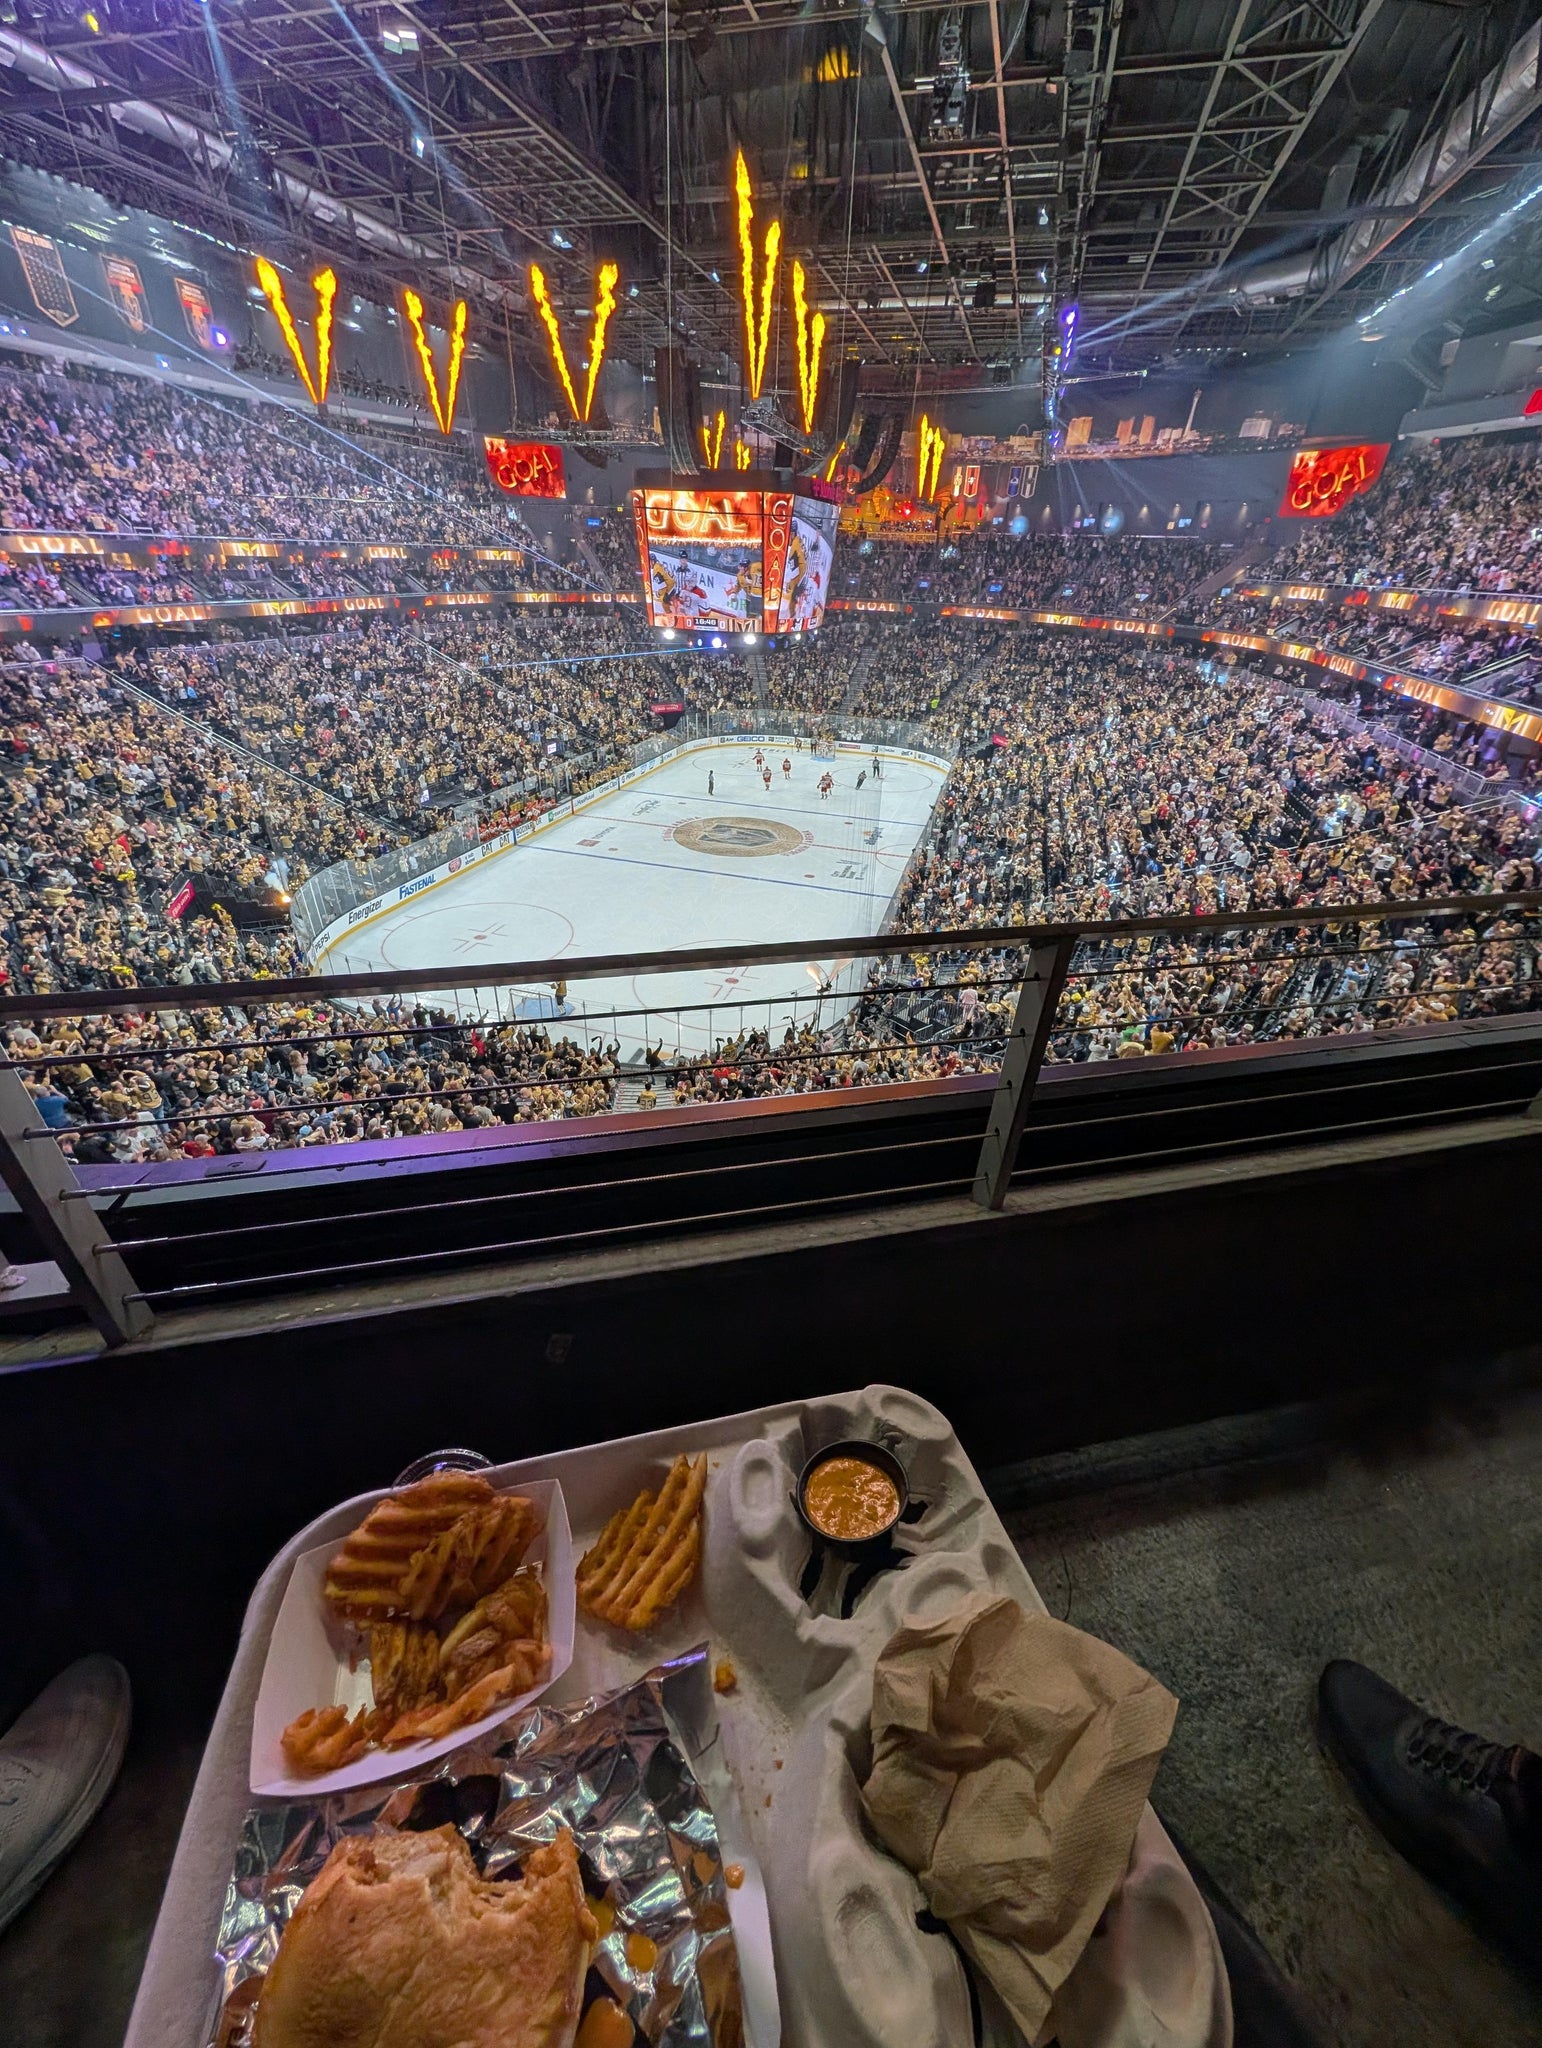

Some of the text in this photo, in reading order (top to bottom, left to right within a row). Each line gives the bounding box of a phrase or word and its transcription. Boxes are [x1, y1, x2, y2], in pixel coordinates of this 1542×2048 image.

[497, 447, 557, 488] GOAL
[1292, 456, 1374, 509] GOAL
[646, 495, 748, 533] GOAL
[17, 536, 104, 555] GOAL
[369, 547, 407, 559] GOAL
[447, 594, 483, 605] GOAL
[1288, 586, 1326, 601] GOAL
[345, 598, 384, 610] GOAL
[856, 602, 895, 612] GOAL
[137, 606, 208, 623] GOAL
[965, 607, 1003, 619] GOAL
[1486, 601, 1542, 625] GOAL
[1114, 619, 1157, 634] GOAL
[1222, 633, 1264, 649] GOAL
[1329, 655, 1357, 676] GOAL
[1403, 684, 1443, 704] GOAL
[499, 833, 510, 848] CAT
[481, 842, 493, 857] CAT
[399, 874, 436, 900] FASTENAL
[348, 899, 383, 925] Energizer
[314, 932, 331, 952] PEPSI
